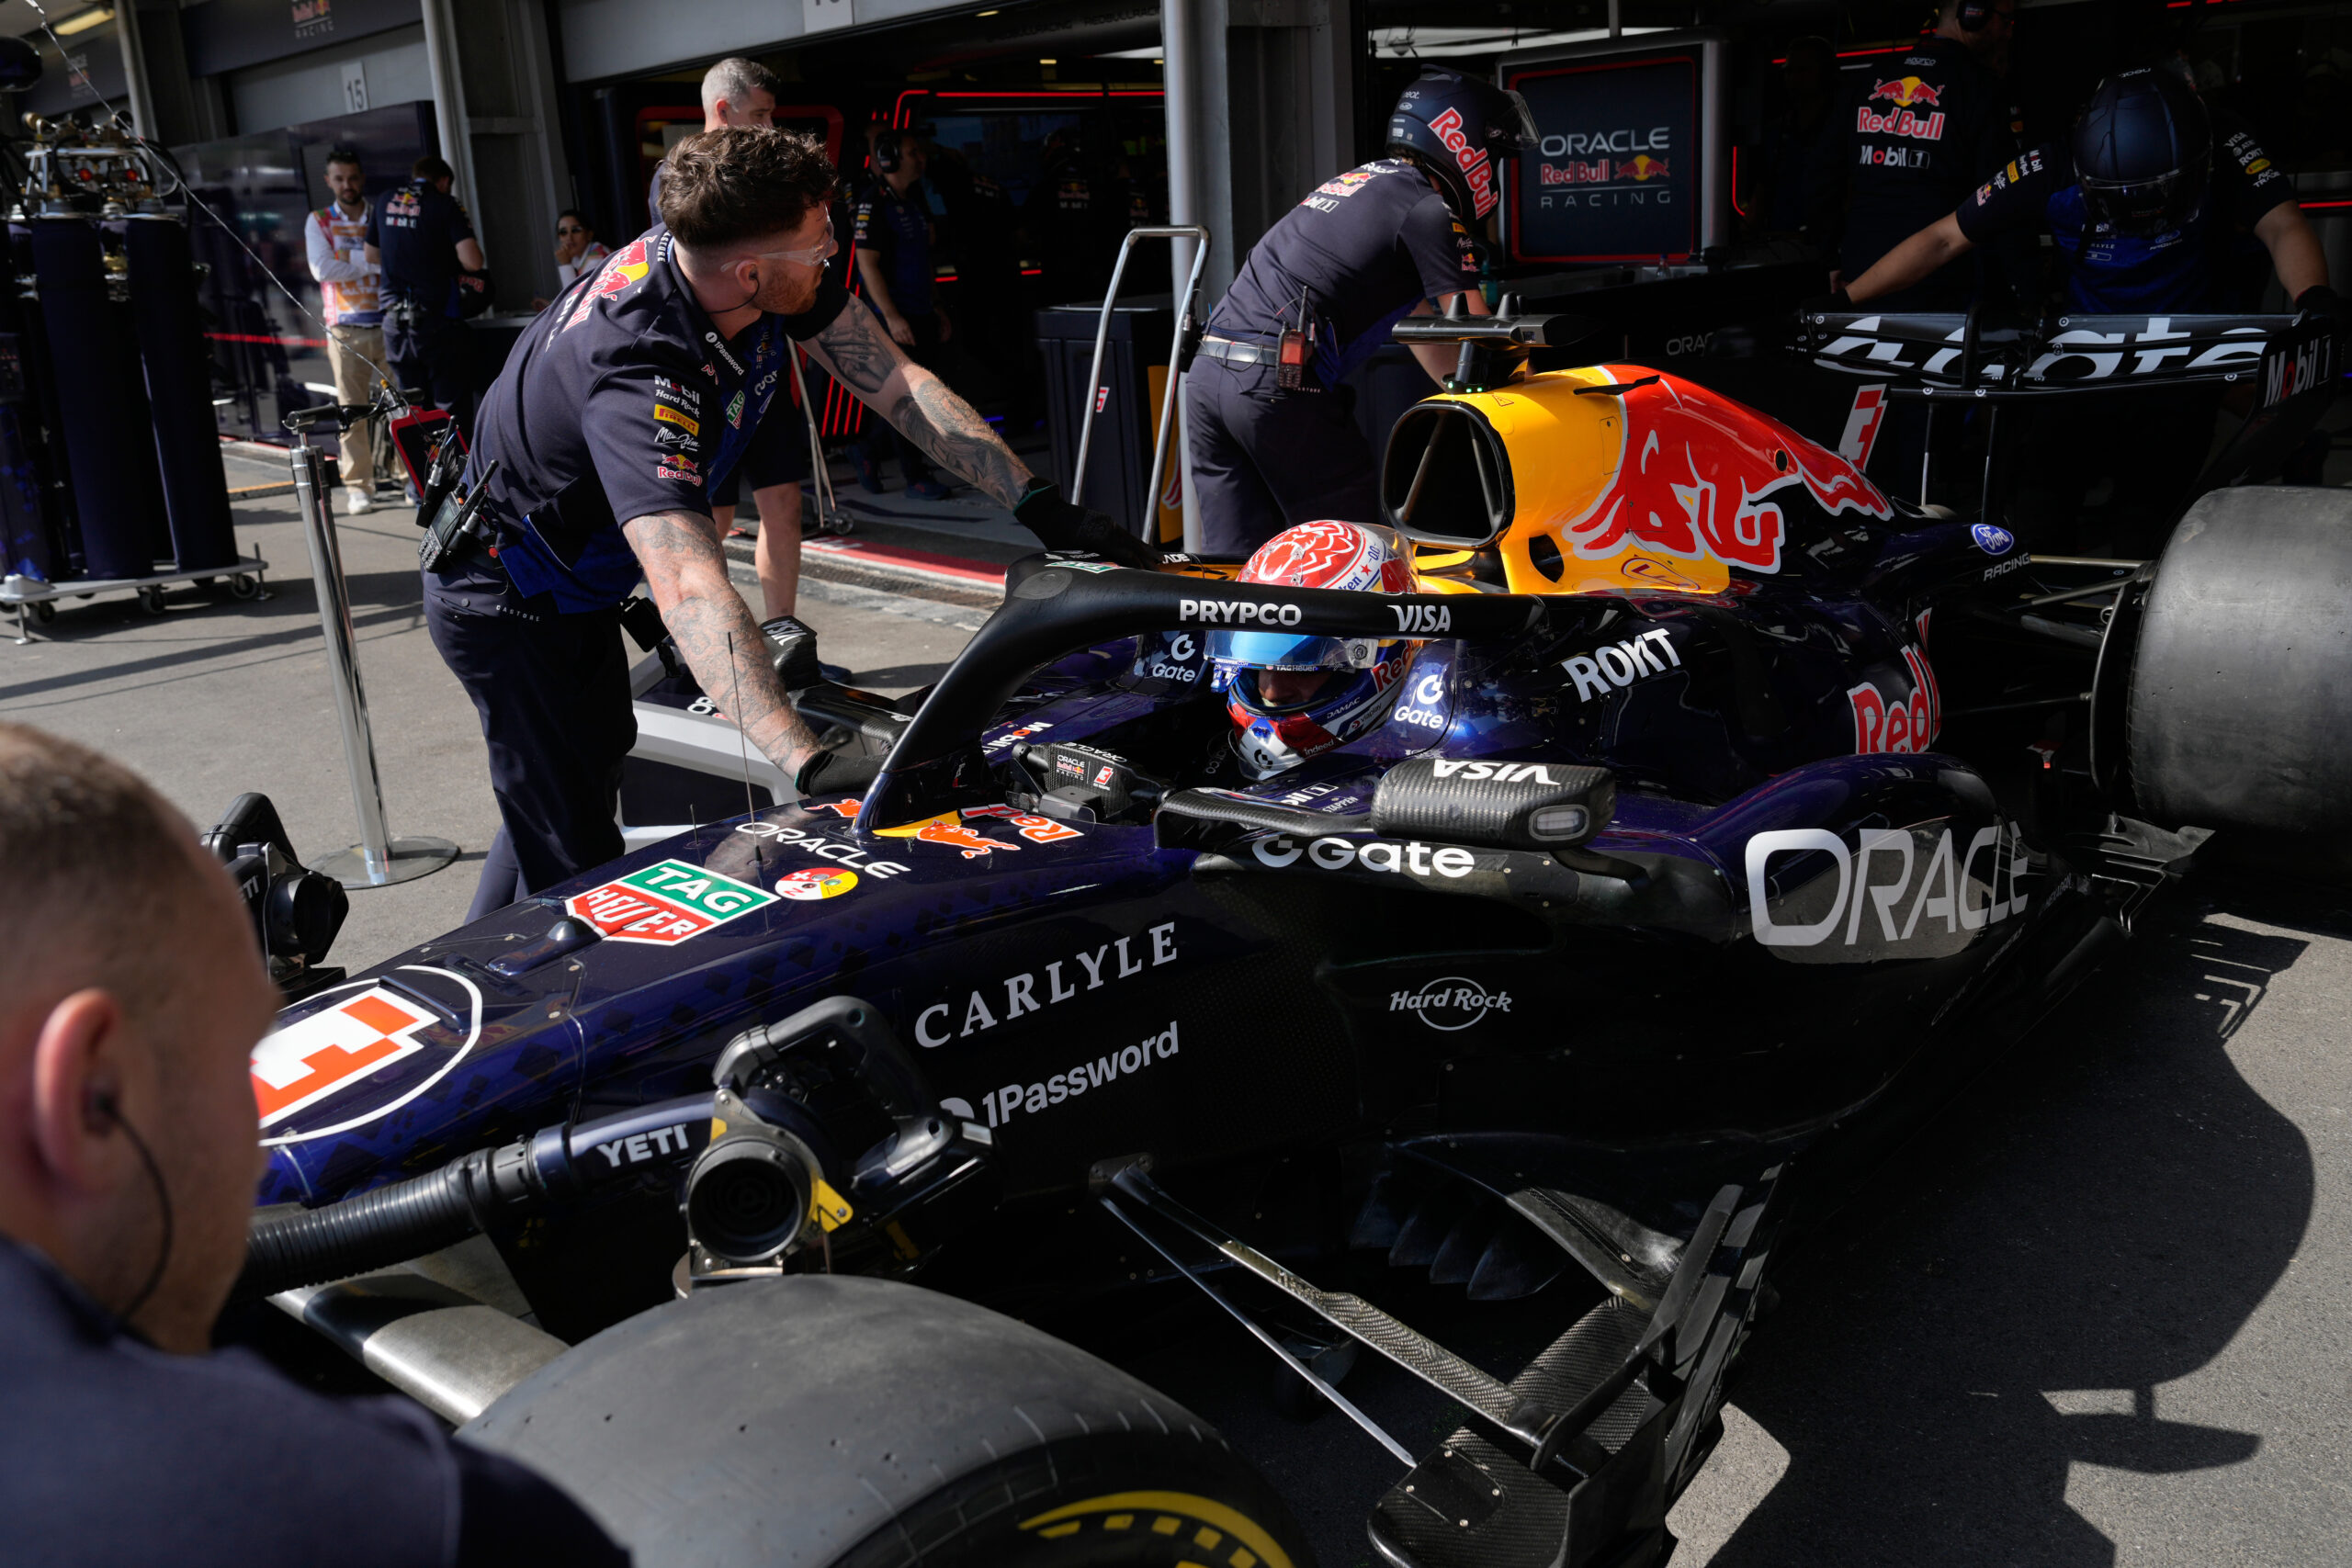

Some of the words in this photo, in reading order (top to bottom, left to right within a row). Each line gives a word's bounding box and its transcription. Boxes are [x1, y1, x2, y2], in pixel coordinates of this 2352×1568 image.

[347, 79, 365, 110] 15
[1857, 106, 1901, 133] Red
[1894, 110, 1946, 141] Bull
[1540, 127, 1670, 157] ORACLE
[1860, 145, 1907, 167] Mobil
[1427, 107, 1488, 173] Red
[1464, 158, 1499, 220] Bull
[1541, 161, 1576, 185] Red
[1576, 159, 1610, 183] Bull
[1541, 191, 1671, 209] RACING
[2263, 337, 2321, 409] Mobil
[654, 375, 700, 404] Mobil
[655, 389, 681, 404] Hard
[681, 399, 700, 418] Rock
[658, 407, 697, 433] PIRELLI
[657, 466, 684, 479] Red
[684, 471, 703, 487] Bull
[1977, 525, 2010, 551] Ford
[1983, 552, 2030, 581] RACING
[495, 604, 541, 621] CASTORE
[1180, 599, 1302, 626] PRYPCO
[1387, 604, 1451, 632] VISA
[1152, 662, 1196, 682] Gate
[1562, 627, 1682, 702] ROKT
[1327, 696, 1361, 719] DAMAC
[1394, 705, 1444, 729] Gate
[988, 721, 1055, 748] Mobil
[1303, 739, 1335, 756] indeed
[1432, 759, 1562, 787] VISA
[735, 821, 912, 879] ORACLE
[642, 863, 752, 913] TAG
[1746, 820, 2030, 946] ORACLE
[586, 885, 700, 938] HEUER
[914, 921, 1179, 1048] CARLYLE
[1388, 989, 1451, 1013] Hard
[1451, 988, 1512, 1014] Rock
[982, 1021, 1180, 1130] 1Password
[597, 1125, 689, 1168] YETI
